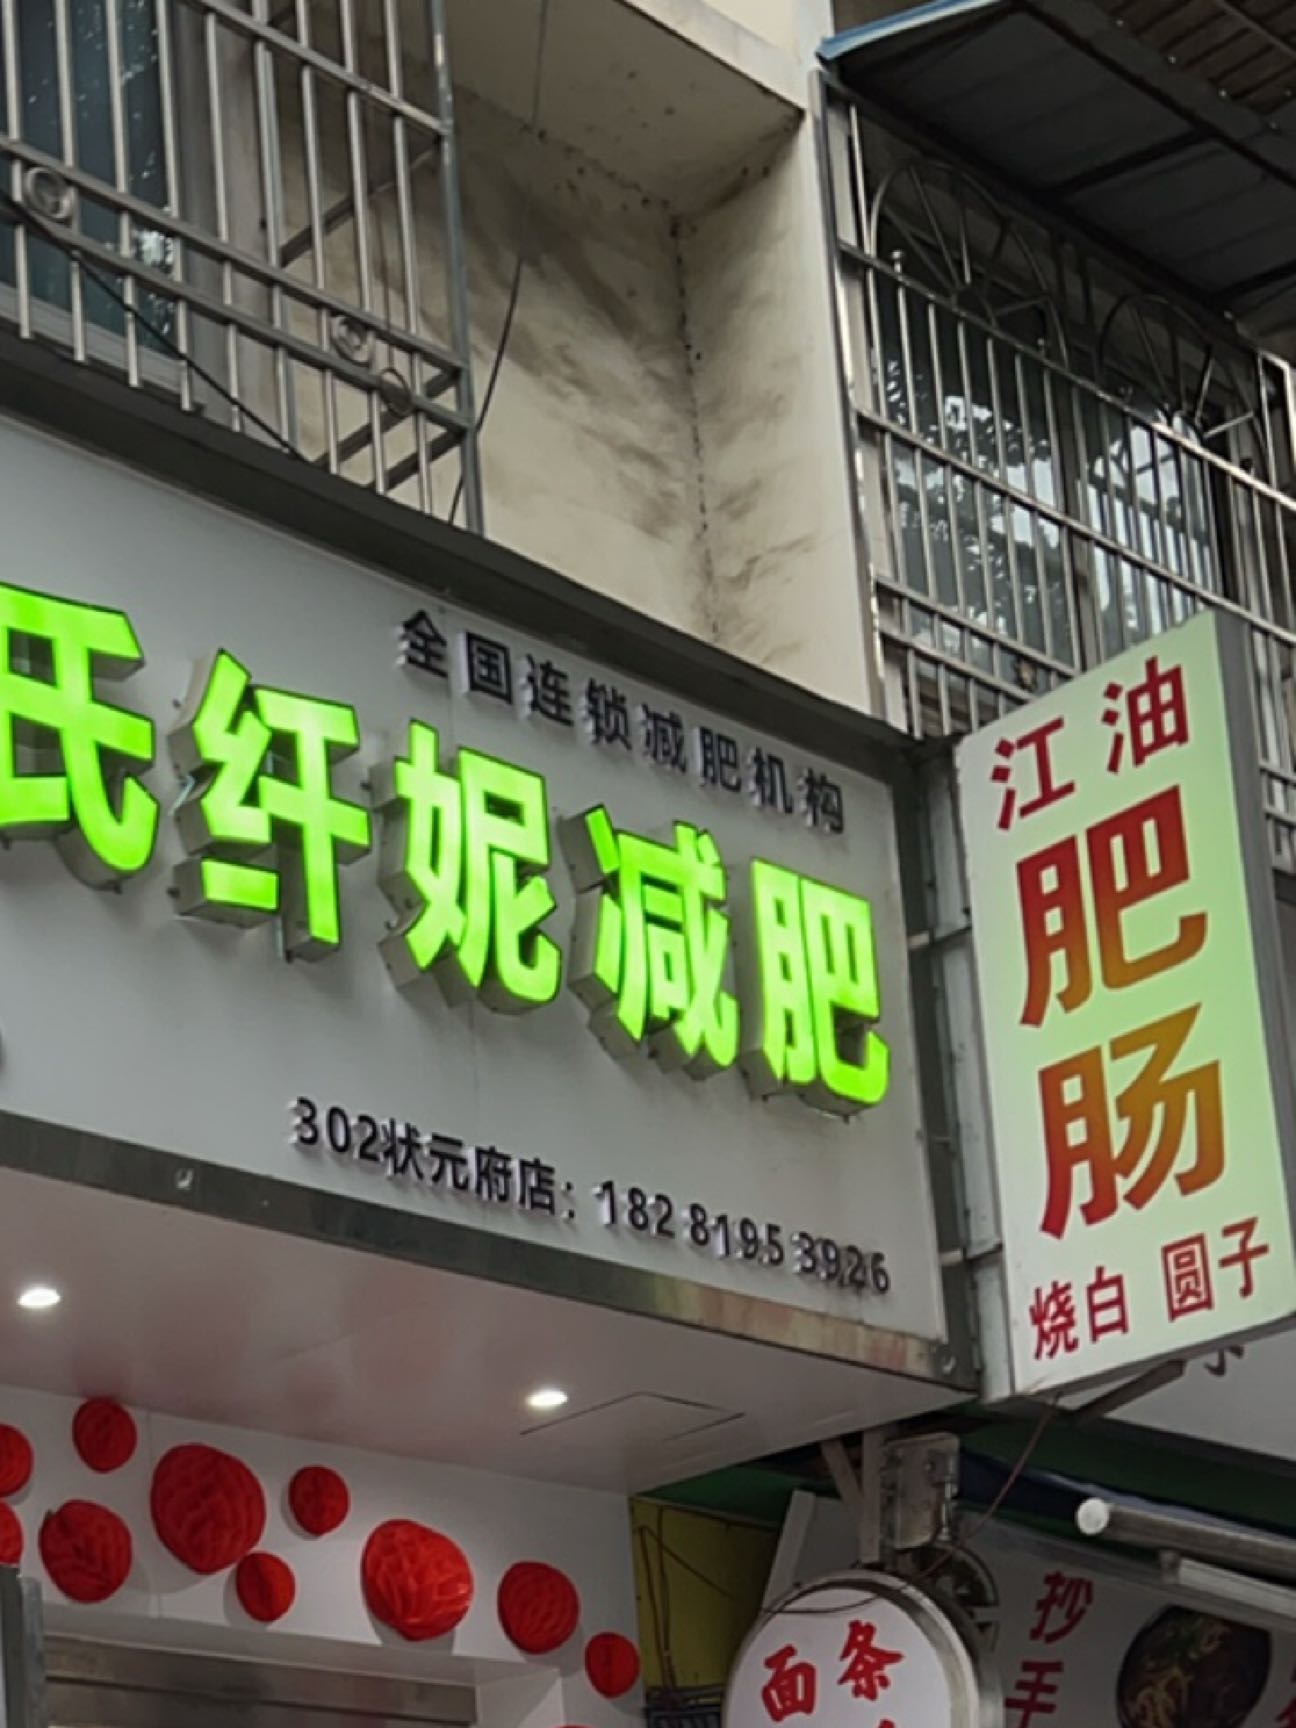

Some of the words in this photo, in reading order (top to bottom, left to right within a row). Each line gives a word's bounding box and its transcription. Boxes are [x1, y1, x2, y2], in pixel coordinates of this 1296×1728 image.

[398, 606, 845, 834] 全国连锁减肥机构
[992, 655, 1191, 832] 江油
[1019, 785, 1229, 1240] 肥肠
[1028, 1270, 1131, 1362] 烧白
[1162, 1215, 1271, 1322] 圆子
[761, 1620, 904, 1722] 面条
